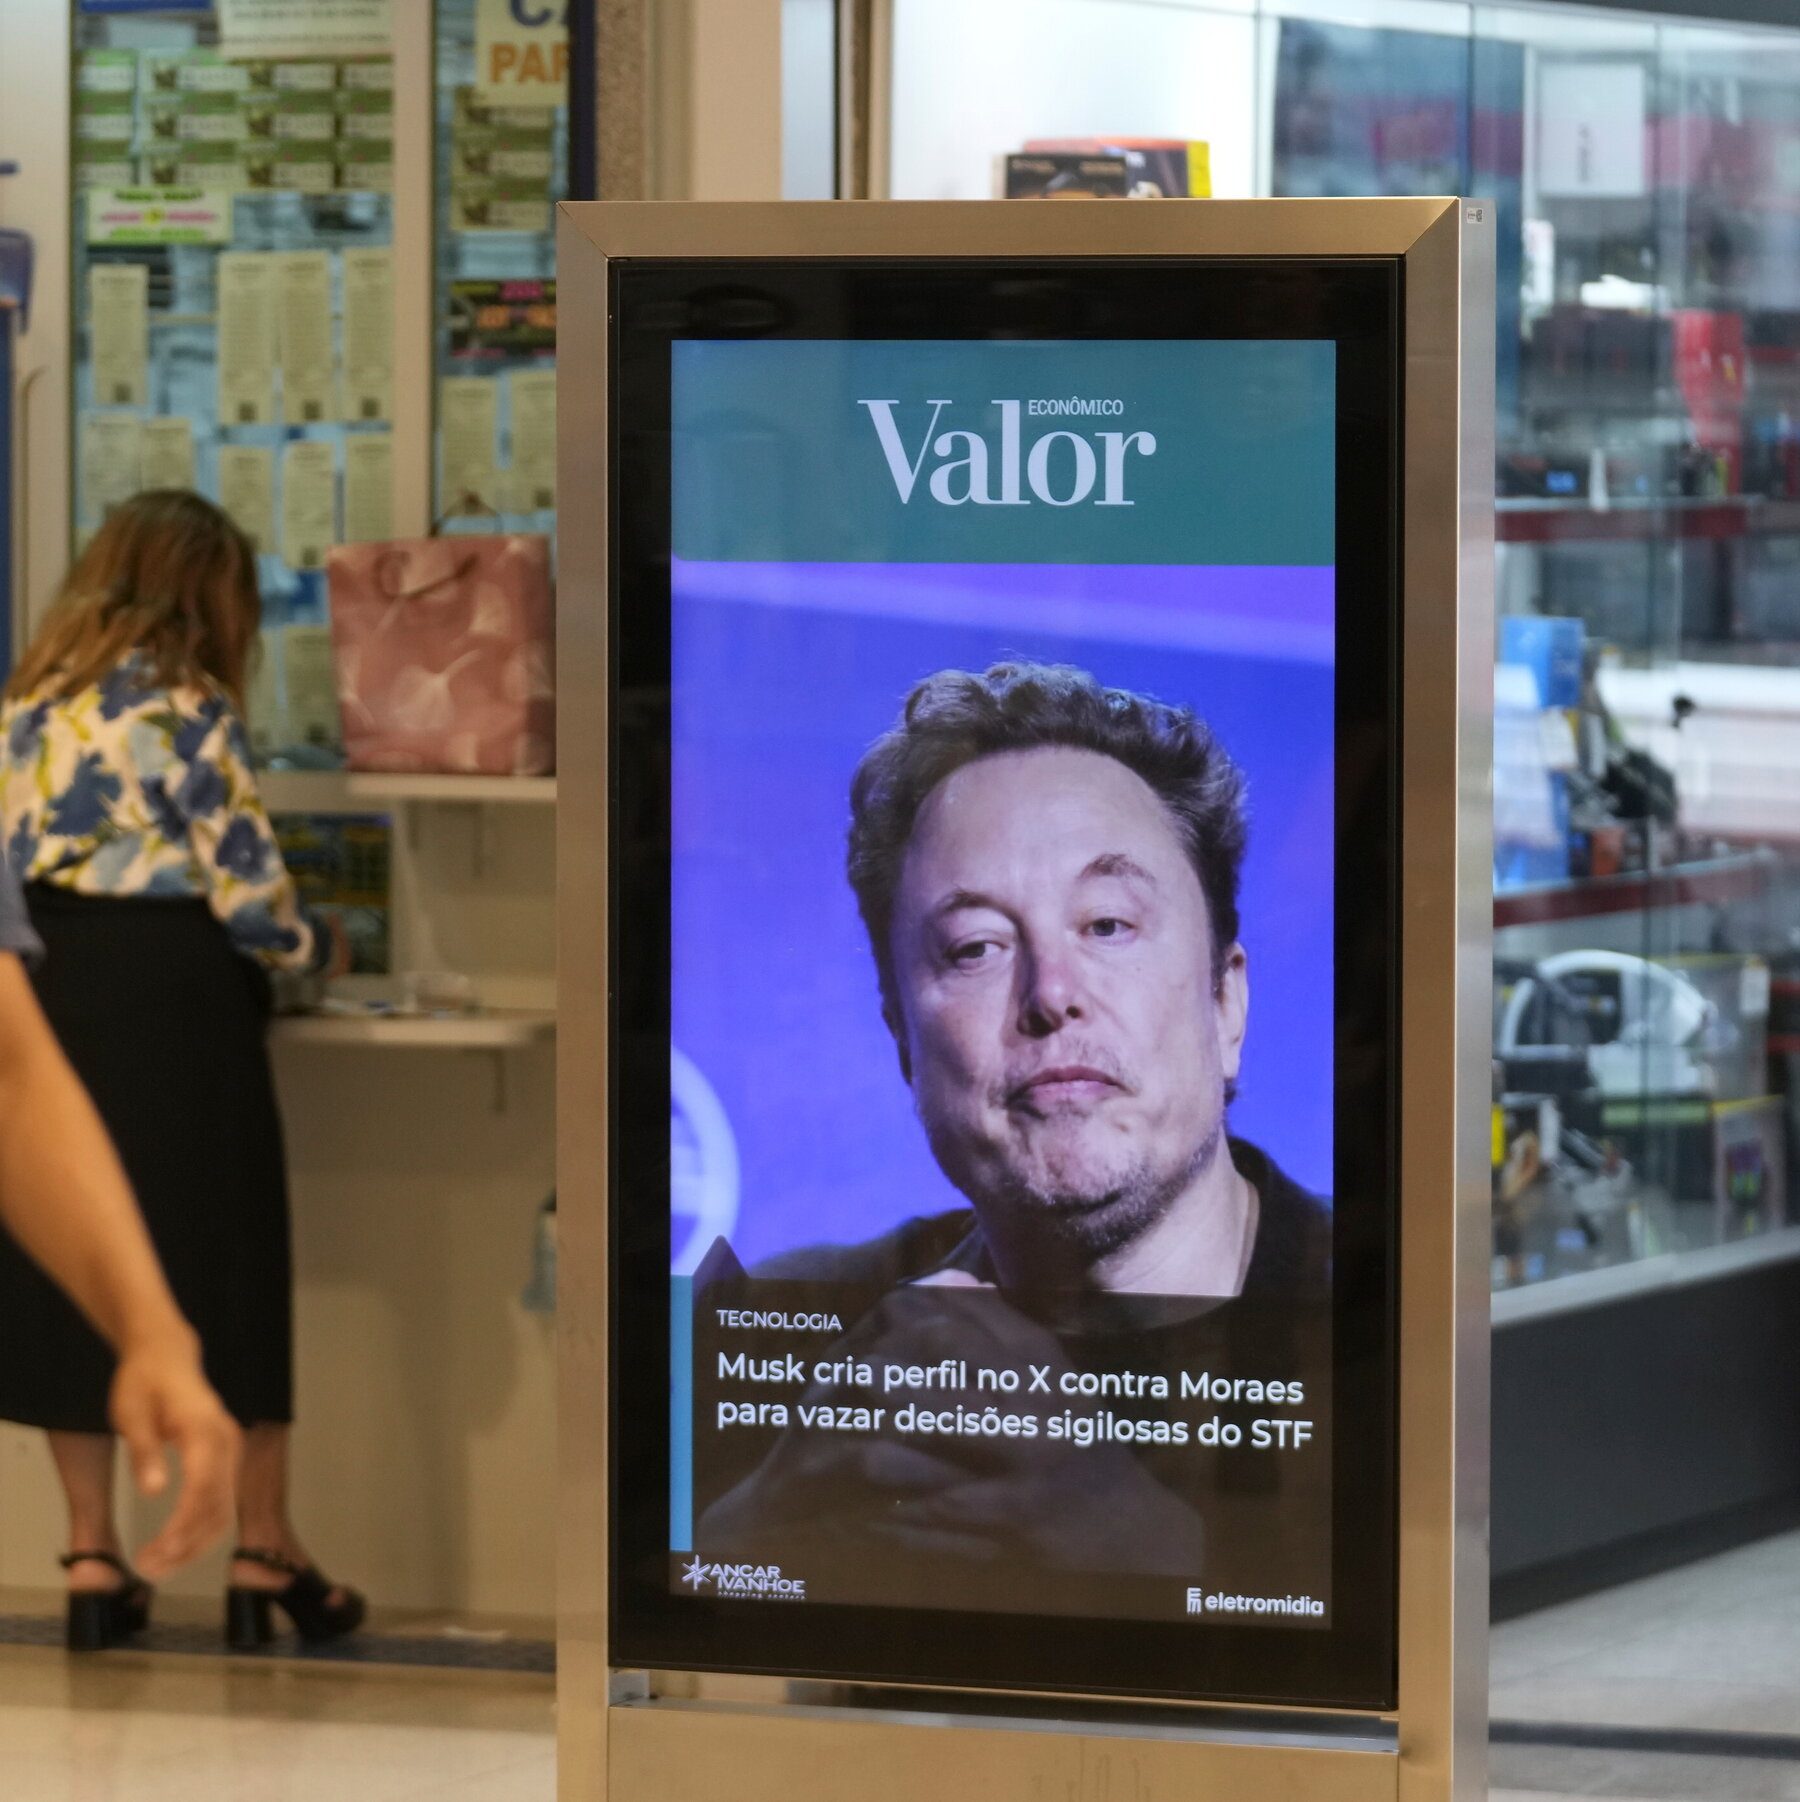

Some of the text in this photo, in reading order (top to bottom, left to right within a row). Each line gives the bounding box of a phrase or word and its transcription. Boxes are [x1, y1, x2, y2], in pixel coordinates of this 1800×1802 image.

[1028, 396, 1124, 416] ECONÔMICO
[857, 399, 1157, 506] Valor
[715, 1308, 843, 1332] TECNOLOGIA
[716, 1351, 1306, 1404] Musk cria perfil no X contra Moraes
[716, 1399, 1315, 1450] para vazar decisões sigilosas do STF
[710, 1563, 781, 1579] ANCAR
[717, 1575, 806, 1593] IVANHOE
[1204, 1591, 1325, 1616] eletromidia
